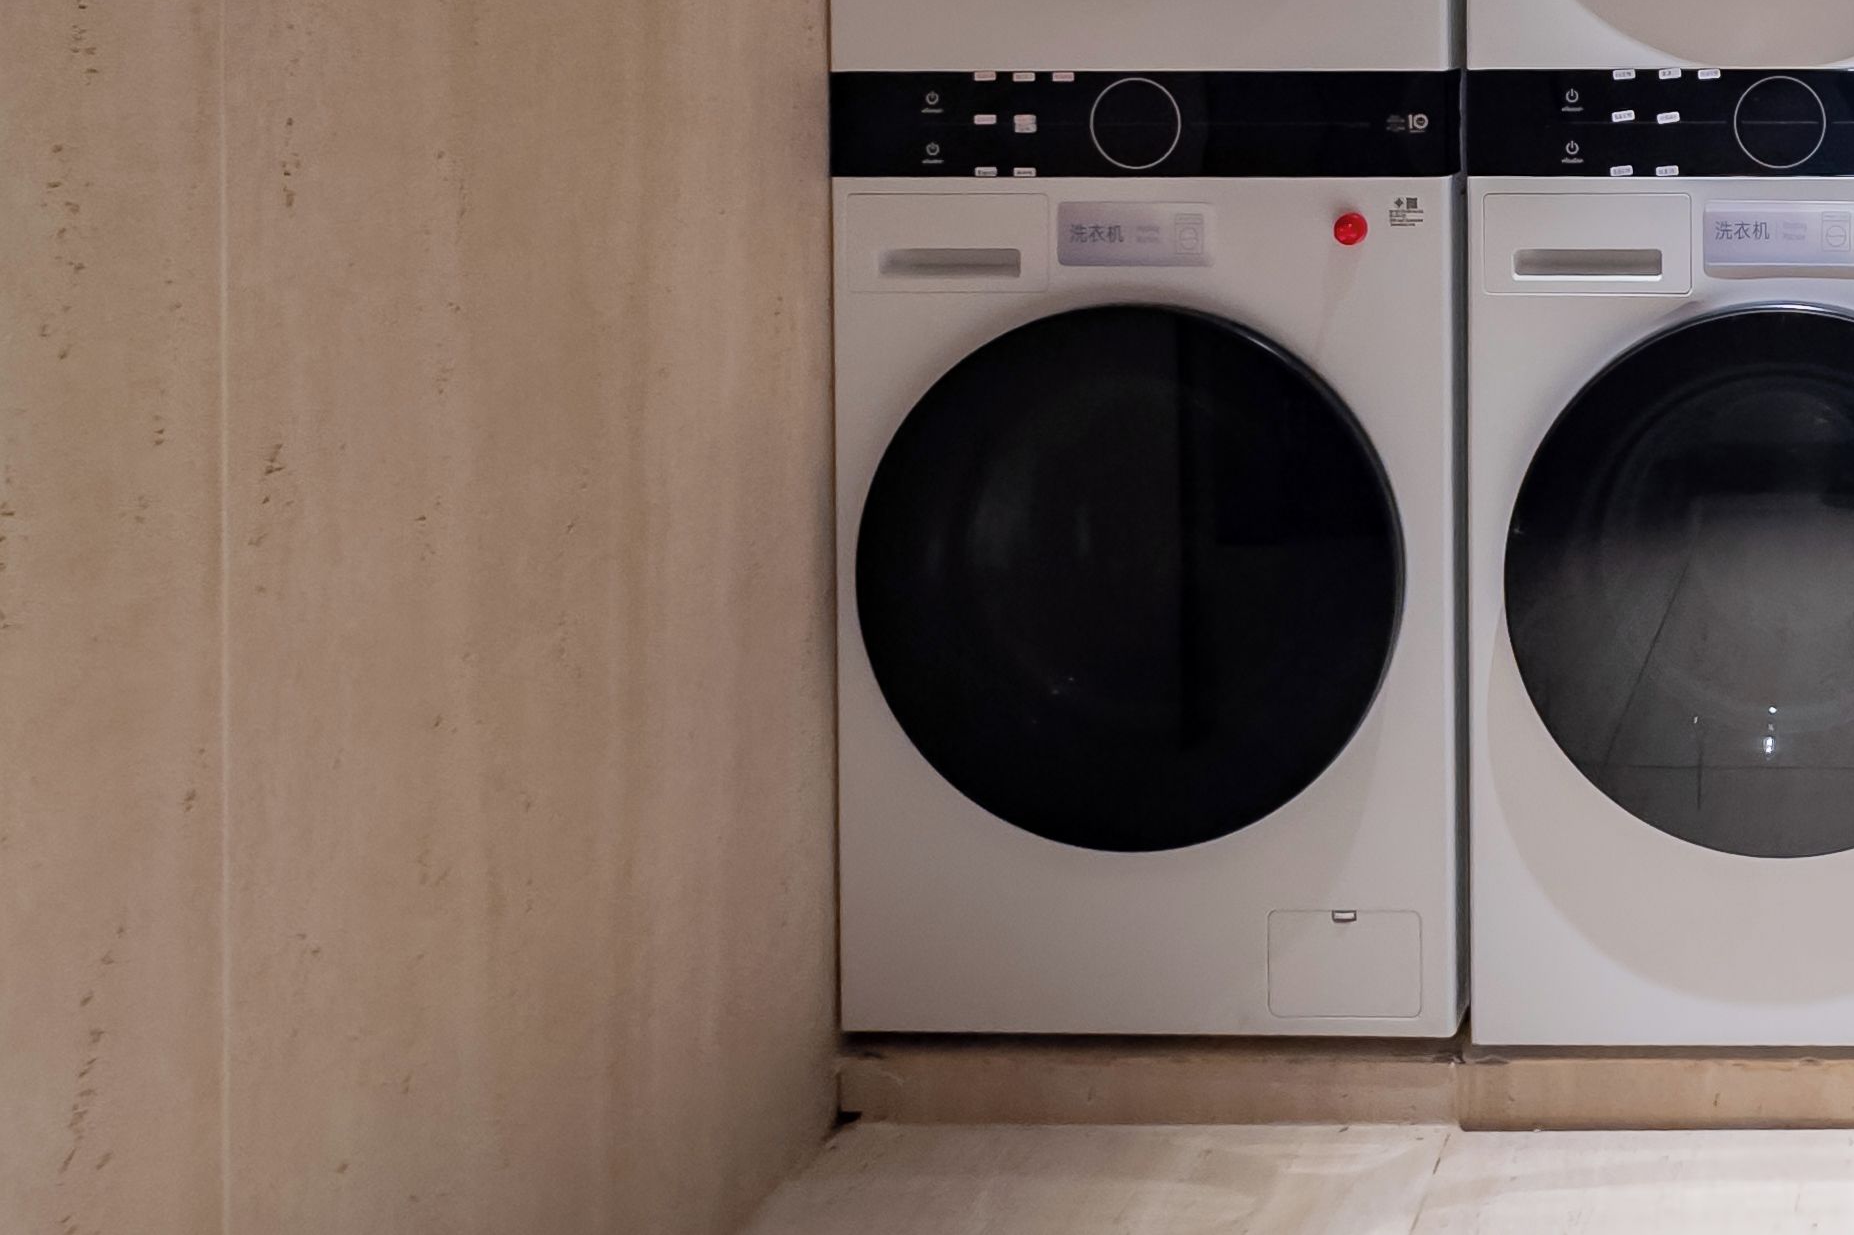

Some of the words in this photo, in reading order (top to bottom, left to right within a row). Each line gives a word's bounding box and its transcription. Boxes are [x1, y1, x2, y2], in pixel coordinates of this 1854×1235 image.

[1068, 223, 1125, 244] 洗衣机
[1714, 220, 1770, 241] 洗衣机
